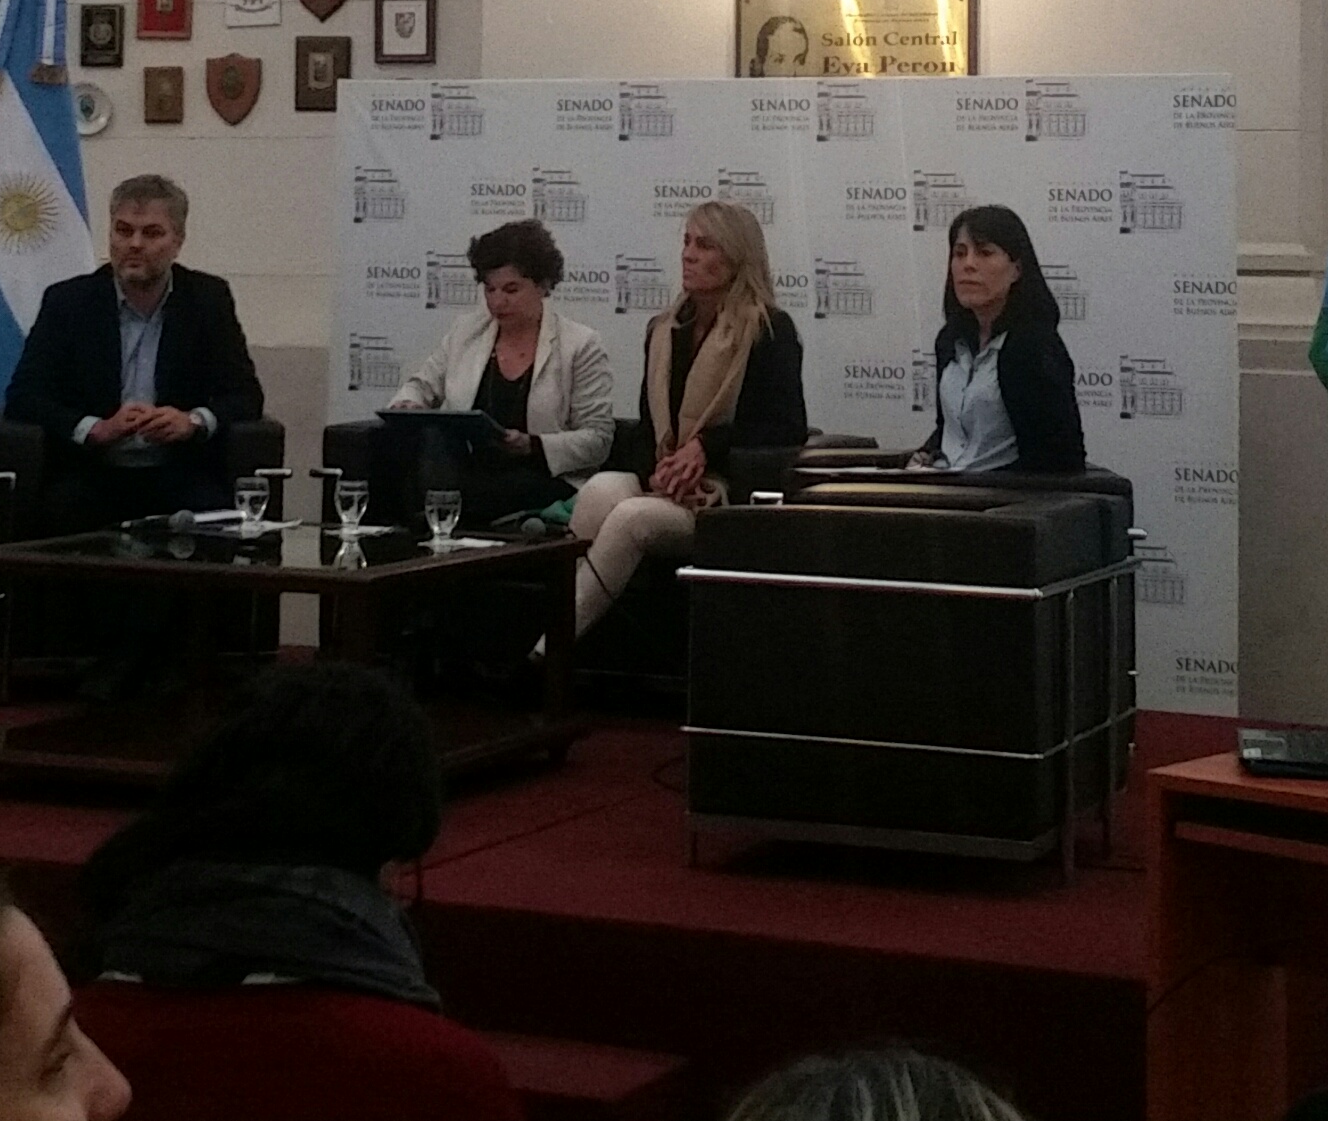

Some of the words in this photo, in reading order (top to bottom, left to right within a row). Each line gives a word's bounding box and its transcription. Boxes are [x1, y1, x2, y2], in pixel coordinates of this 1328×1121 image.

[821, 31, 877, 47] Salón
[883, 30, 957, 46] Central
[823, 56, 870, 74] Eva
[371, 99, 425, 112] SENADO
[557, 98, 613, 111] SENADO
[751, 98, 811, 111] SENADO
[956, 97, 1019, 111] SENADO
[1172, 94, 1237, 108] SENADO
[470, 183, 526, 196] SENADO
[654, 185, 712, 198] SENADO
[845, 187, 907, 200] SENADO
[1048, 188, 1113, 202] SENADO
[366, 266, 421, 279] SENADO
[566, 271, 610, 284] NADO
[775, 274, 809, 288] ADO
[844, 366, 906, 380] SENADO
[1076, 372, 1114, 387] ADO
